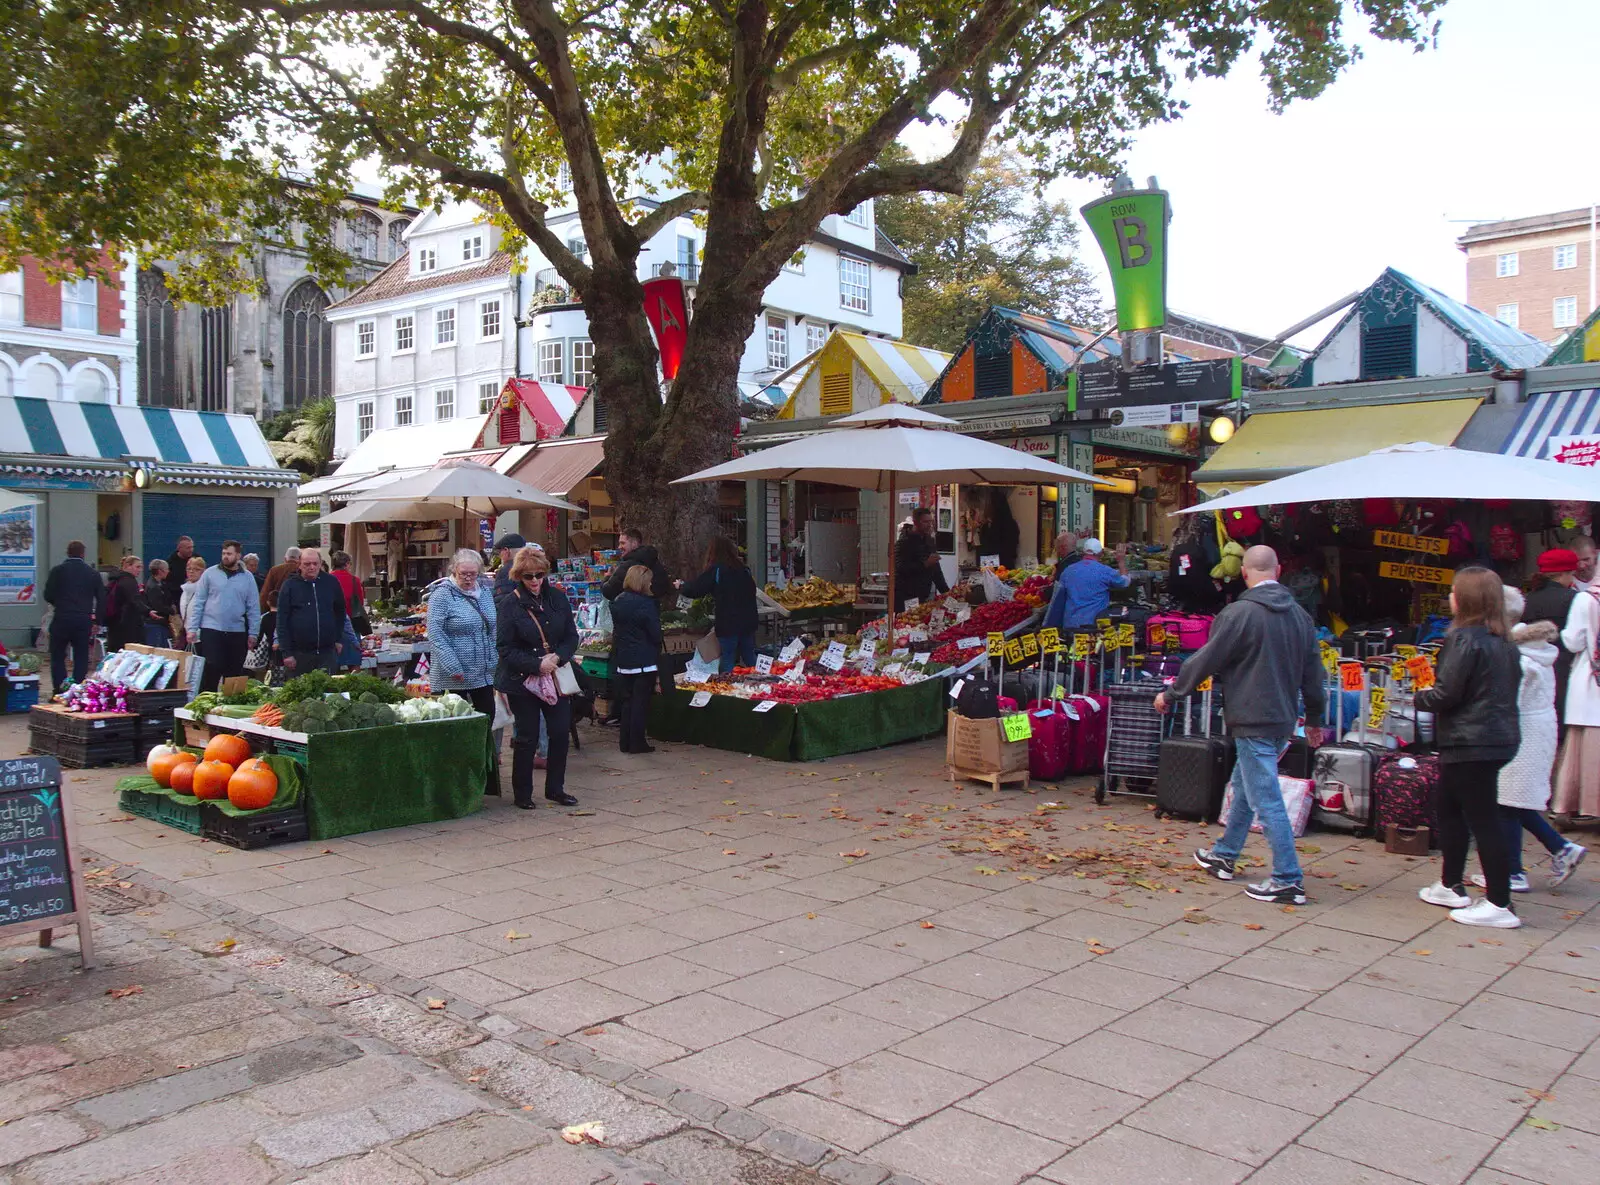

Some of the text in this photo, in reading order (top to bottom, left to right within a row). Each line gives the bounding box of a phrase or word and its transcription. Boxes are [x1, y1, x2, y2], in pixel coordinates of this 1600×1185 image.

[1110, 202, 1137, 217] ROW
[1113, 215, 1153, 269] B
[658, 295, 681, 335] A
[951, 424, 972, 432] FRESH
[973, 422, 992, 431] FRUIT
[1000, 417, 1043, 430] VEGETABLES
[1021, 437, 1050, 453] Sons
[1093, 428, 1119, 441] FRESH
[1119, 431, 1138, 444] AND
[1138, 433, 1163, 448] TASTY
[1563, 446, 1597, 457] SUPER
[1380, 533, 1441, 552] WALLETS
[1390, 564, 1443, 582] PURSES
[5, 760, 39, 774] Selling
[21, 768, 46, 785] Tea!
[17, 817, 46, 839] Tea
[24, 844, 57, 859] Loose
[47, 898, 64, 912] 50
